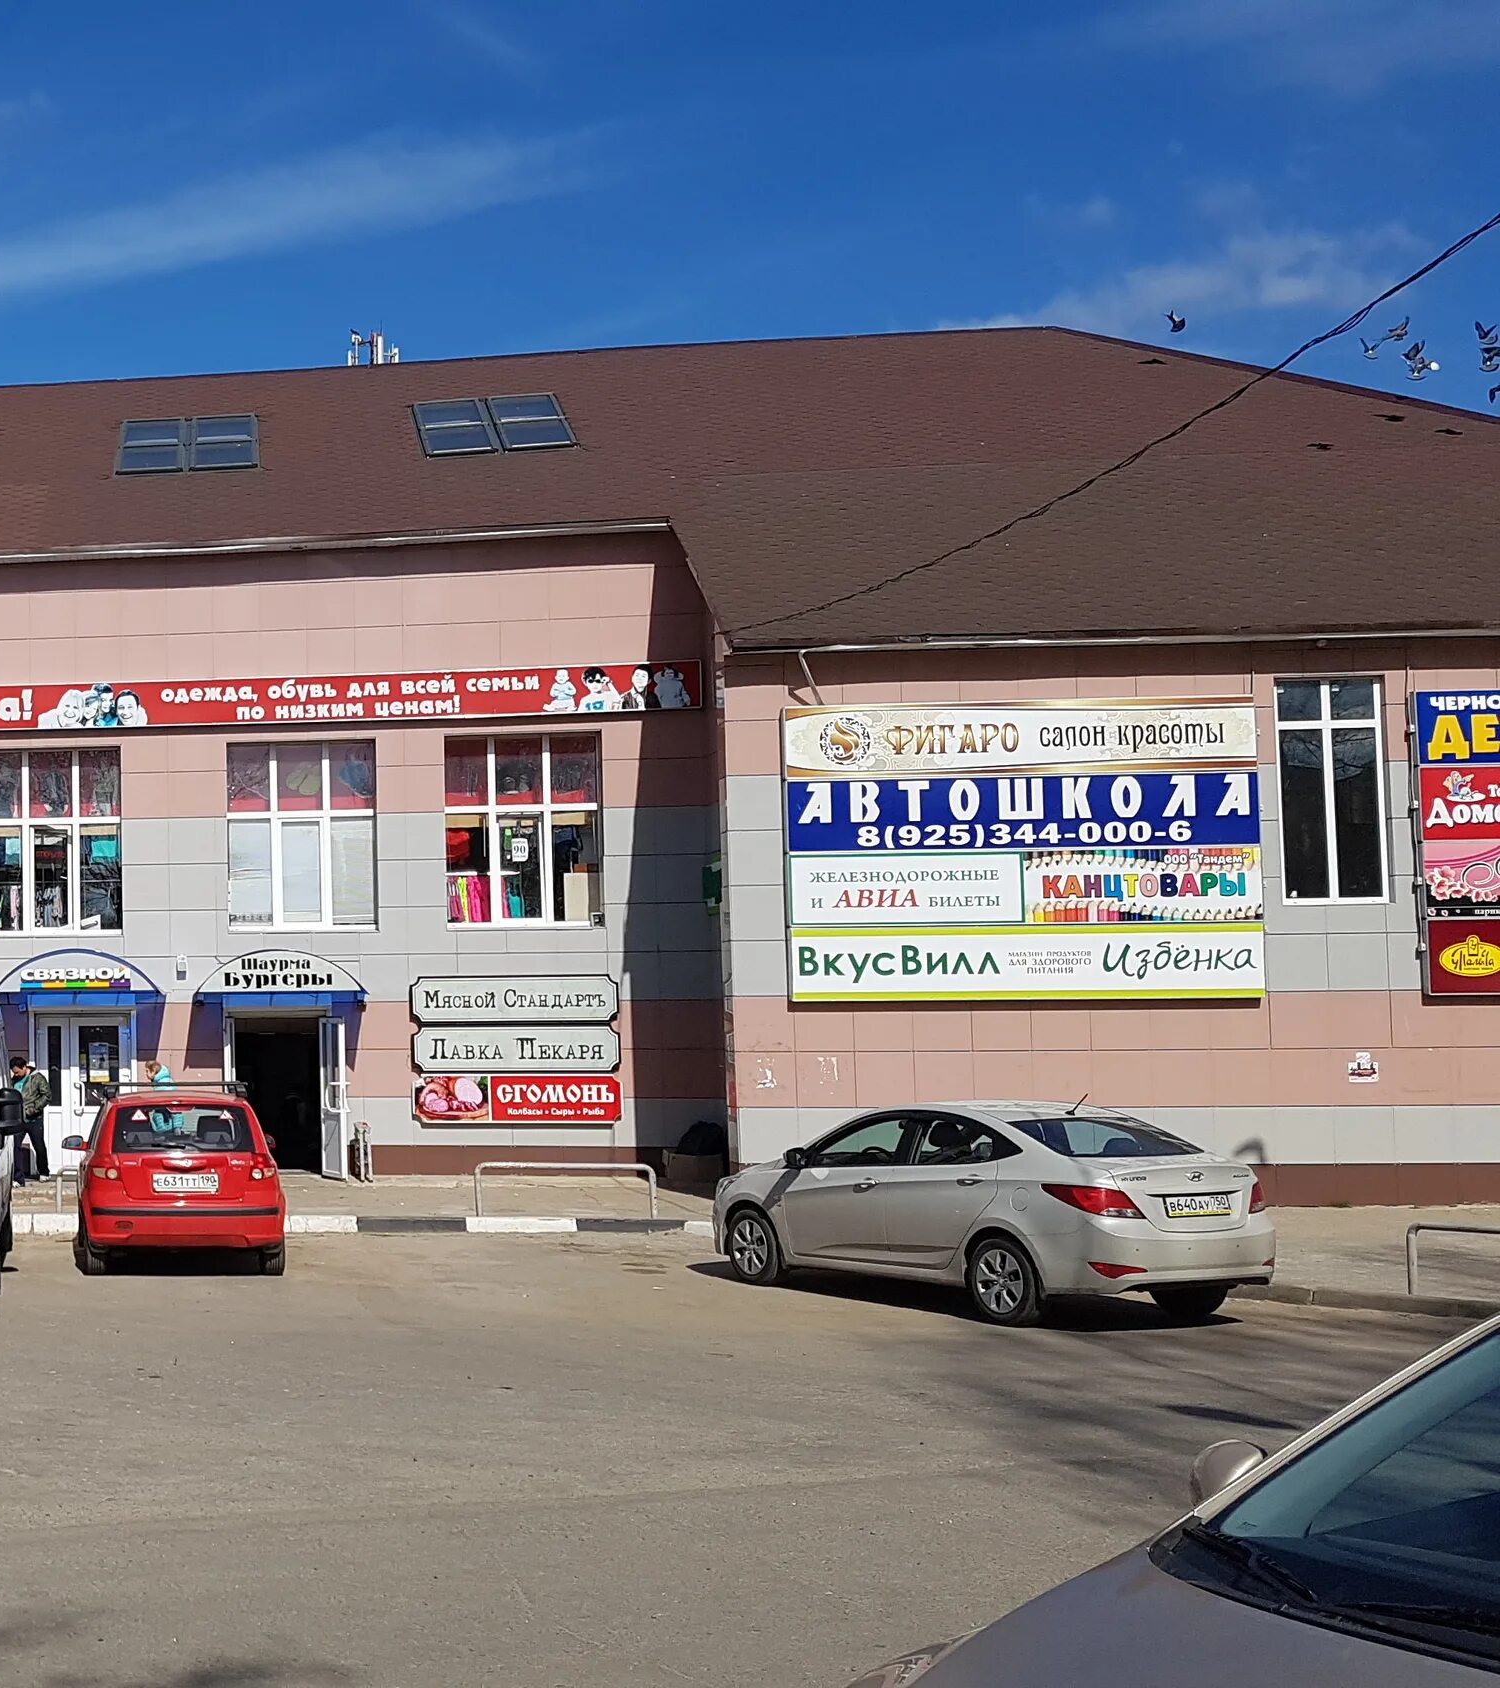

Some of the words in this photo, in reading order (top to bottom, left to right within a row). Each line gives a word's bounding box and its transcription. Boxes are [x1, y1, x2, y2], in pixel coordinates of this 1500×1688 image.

[160, 685, 259, 704] одежда,
[267, 679, 337, 702] обувь
[346, 681, 391, 699] для
[400, 674, 456, 695] всей
[465, 675, 540, 693] семьи
[236, 705, 265, 721] по
[275, 702, 364, 719] низким
[374, 694, 461, 718] ценам!
[884, 722, 1019, 756] ФИГАРО
[1039, 722, 1106, 750] салон
[1117, 721, 1226, 754] красоты
[1427, 713, 1500, 760] ДЕ
[798, 773, 1250, 826] АВТОШКОЛА
[1487, 784, 1500, 798] Т
[857, 820, 1193, 848] 8(925)344-000-6
[513, 844, 527, 855] 90
[1163, 854, 1188, 865] ООО
[809, 868, 1000, 885] ЖЕЛЕЗНОДОРОЖНЫЕ
[1042, 871, 1246, 902] КАНЦТОВАРЫ
[810, 896, 823, 910] И
[831, 888, 920, 910] АВИА
[928, 893, 1001, 909] БИЛЕТЫ
[240, 957, 312, 973] Шаурма
[798, 944, 1001, 984] ВкусВилл
[1008, 958, 1027, 966] ДЛЯ
[1031, 957, 1092, 966] ЗДОРОВОГО
[1026, 966, 1074, 974] ПИТАНИЯ
[1102, 940, 1258, 982] Избёнка
[19, 964, 132, 983] СВЯЗНОЙ
[223, 972, 333, 989] Бургеры
[507, 1106, 543, 1116] Колбасы
[551, 1107, 575, 1118] Сыры
[582, 1107, 605, 1116] Рыба
